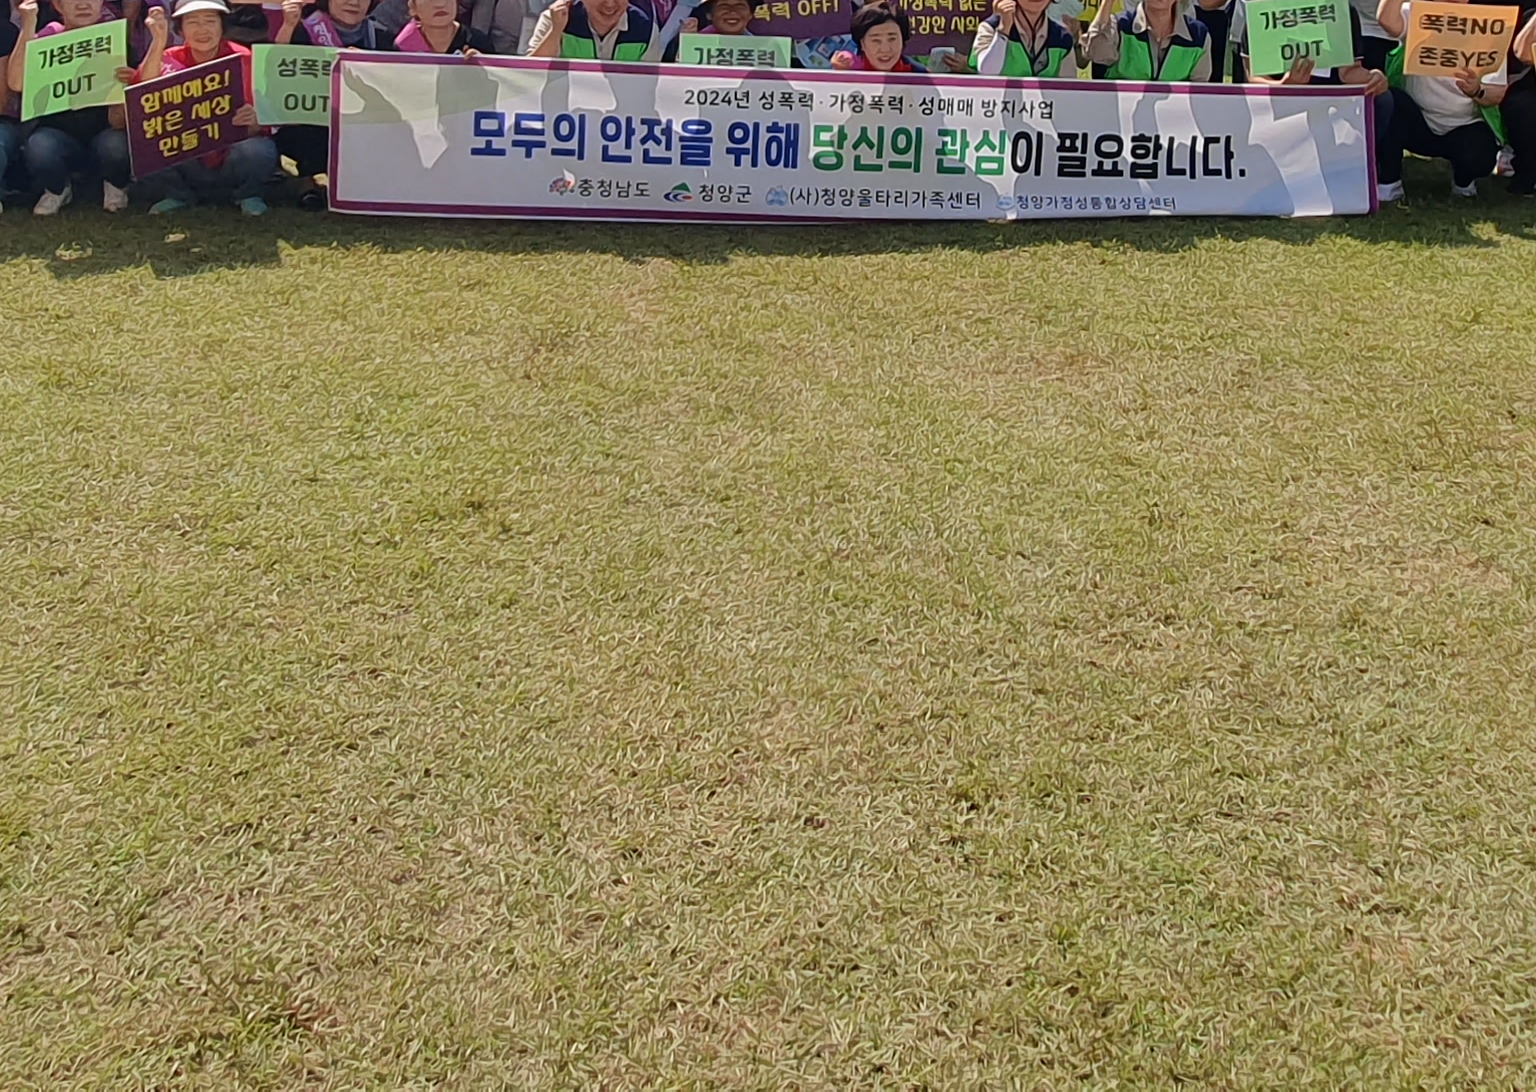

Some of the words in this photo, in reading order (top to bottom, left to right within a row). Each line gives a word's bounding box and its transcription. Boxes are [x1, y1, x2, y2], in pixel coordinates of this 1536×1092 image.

[753, 1, 791, 22] 폭력
[1260, 3, 1336, 30] 가정폭력
[1420, 13, 1505, 36] 폭력NO
[37, 34, 112, 70] 가정폭력
[693, 46, 776, 67] 가정폭력
[1280, 39, 1324, 61] OUT
[1418, 46, 1499, 68] 존중YES
[51, 73, 97, 100] OUT
[142, 109, 184, 139] 밝은
[190, 93, 232, 120] 세상
[283, 93, 330, 112] OUT
[684, 89, 751, 111] 2024년
[758, 89, 814, 113] 성폭력
[829, 94, 905, 116] 가정폭력
[917, 95, 975, 118] 성매매
[980, 98, 1054, 120] 방지사업
[158, 121, 220, 158] 만들기
[469, 110, 587, 161] 모두의
[599, 115, 714, 167] 안전을
[724, 120, 801, 169] 위해
[812, 123, 924, 174] 당신의
[934, 127, 1044, 177] 관심이
[1056, 130, 1247, 180] 필요합니다.
[577, 178, 651, 199] 충청남도
[698, 184, 753, 205] 청양군
[789, 187, 982, 210] (사)청양울타리가족센터
[1015, 195, 1177, 211] 청양가정성통합상담센터
